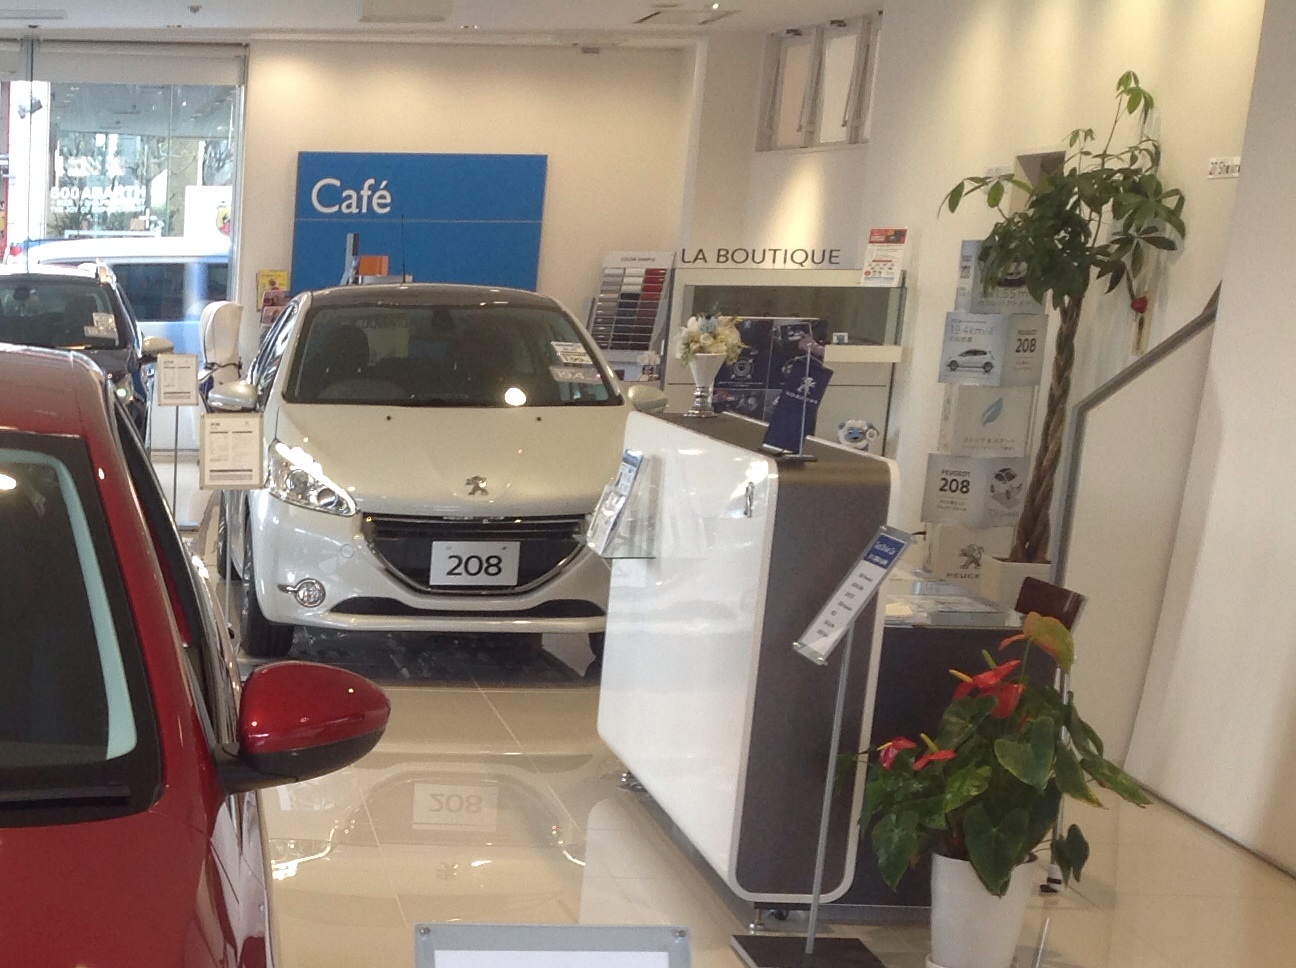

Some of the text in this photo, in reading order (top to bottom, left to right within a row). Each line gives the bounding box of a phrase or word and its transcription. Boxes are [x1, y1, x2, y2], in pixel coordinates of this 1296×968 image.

[310, 177, 392, 215] Café
[681, 247, 841, 268] LA BOUTIQUE
[1015, 337, 1037, 353] 208
[938, 478, 971, 495] 208
[445, 554, 503, 576] 208
